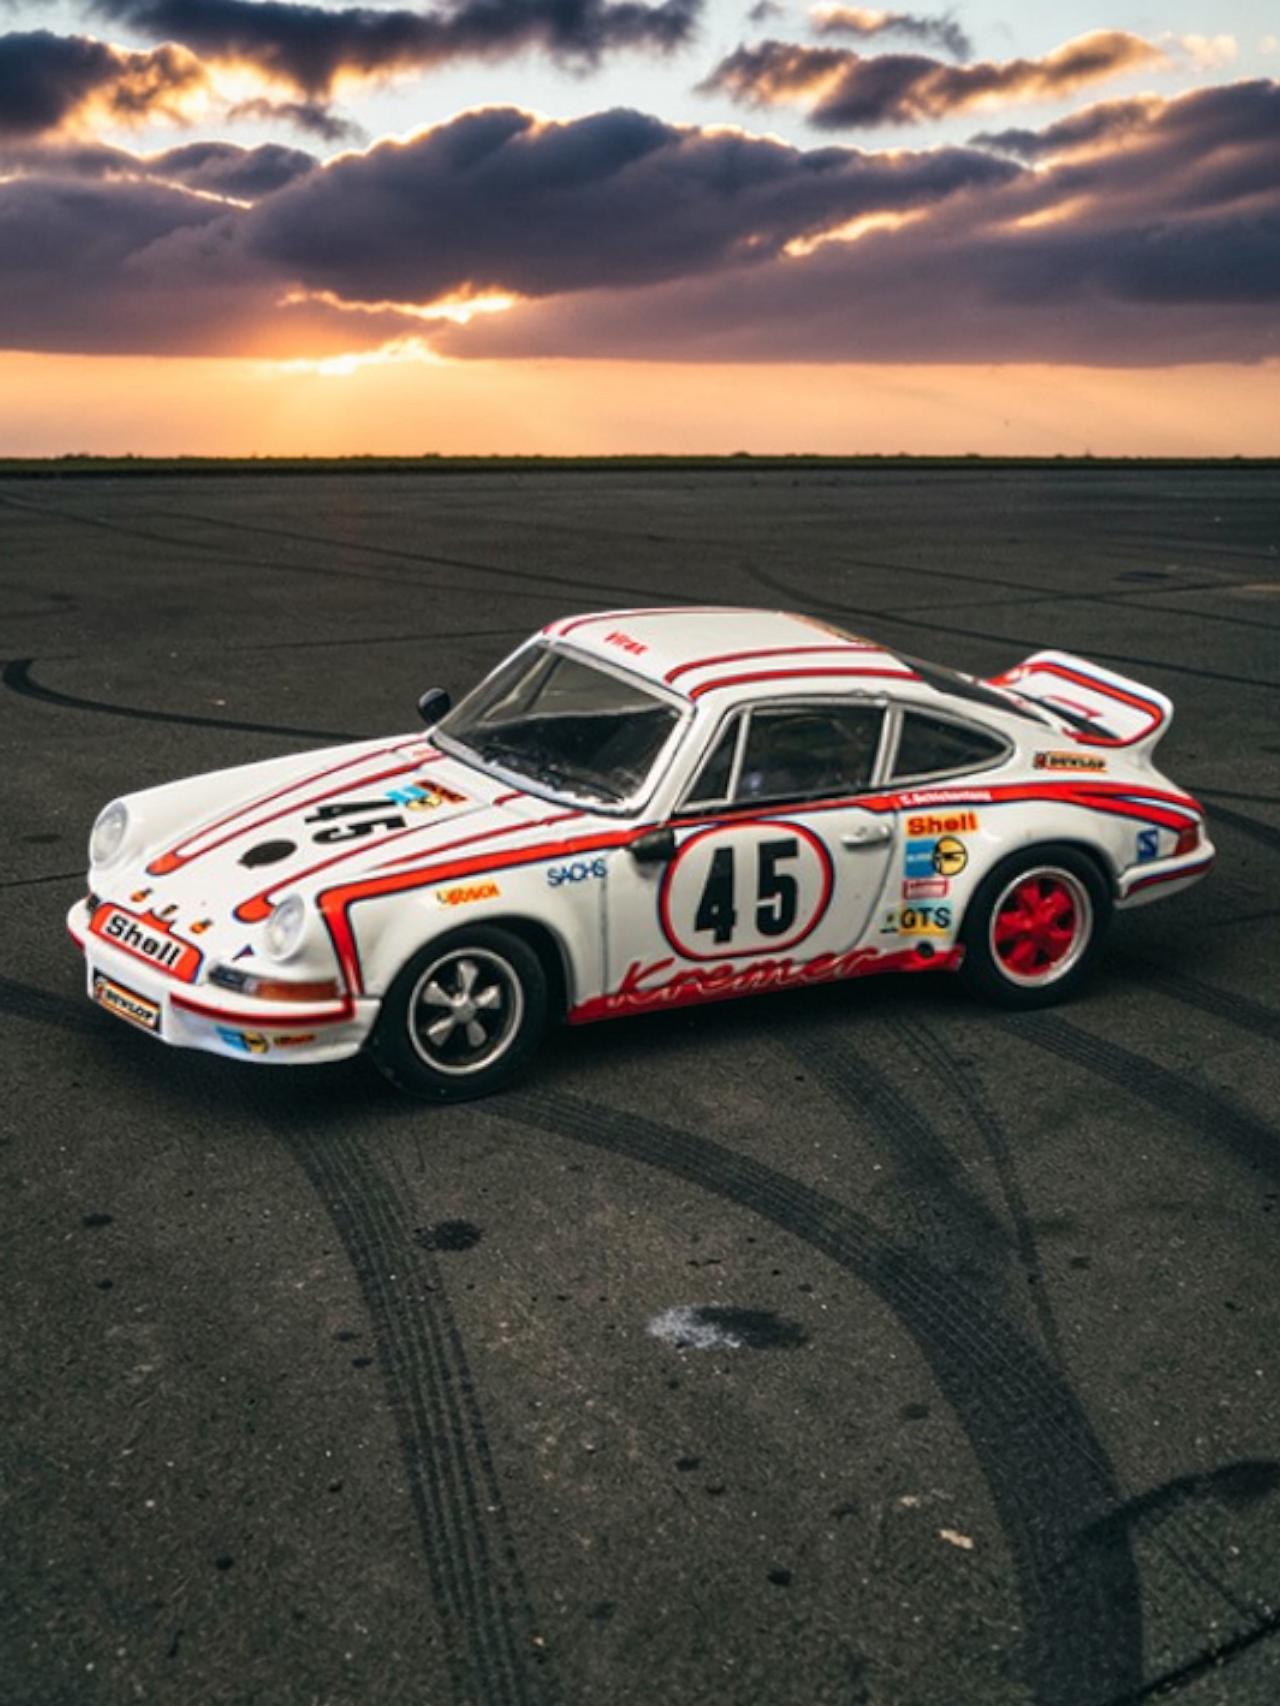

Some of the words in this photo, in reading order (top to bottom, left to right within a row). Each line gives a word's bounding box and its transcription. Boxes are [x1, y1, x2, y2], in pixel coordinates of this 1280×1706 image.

[305, 800, 406, 843] 45
[908, 811, 977, 836] Shell
[547, 858, 608, 887] SACHS
[694, 838, 799, 944] 45
[901, 907, 952, 929] GTS
[105, 914, 183, 966] Shell
[606, 947, 880, 1008] Kremer
